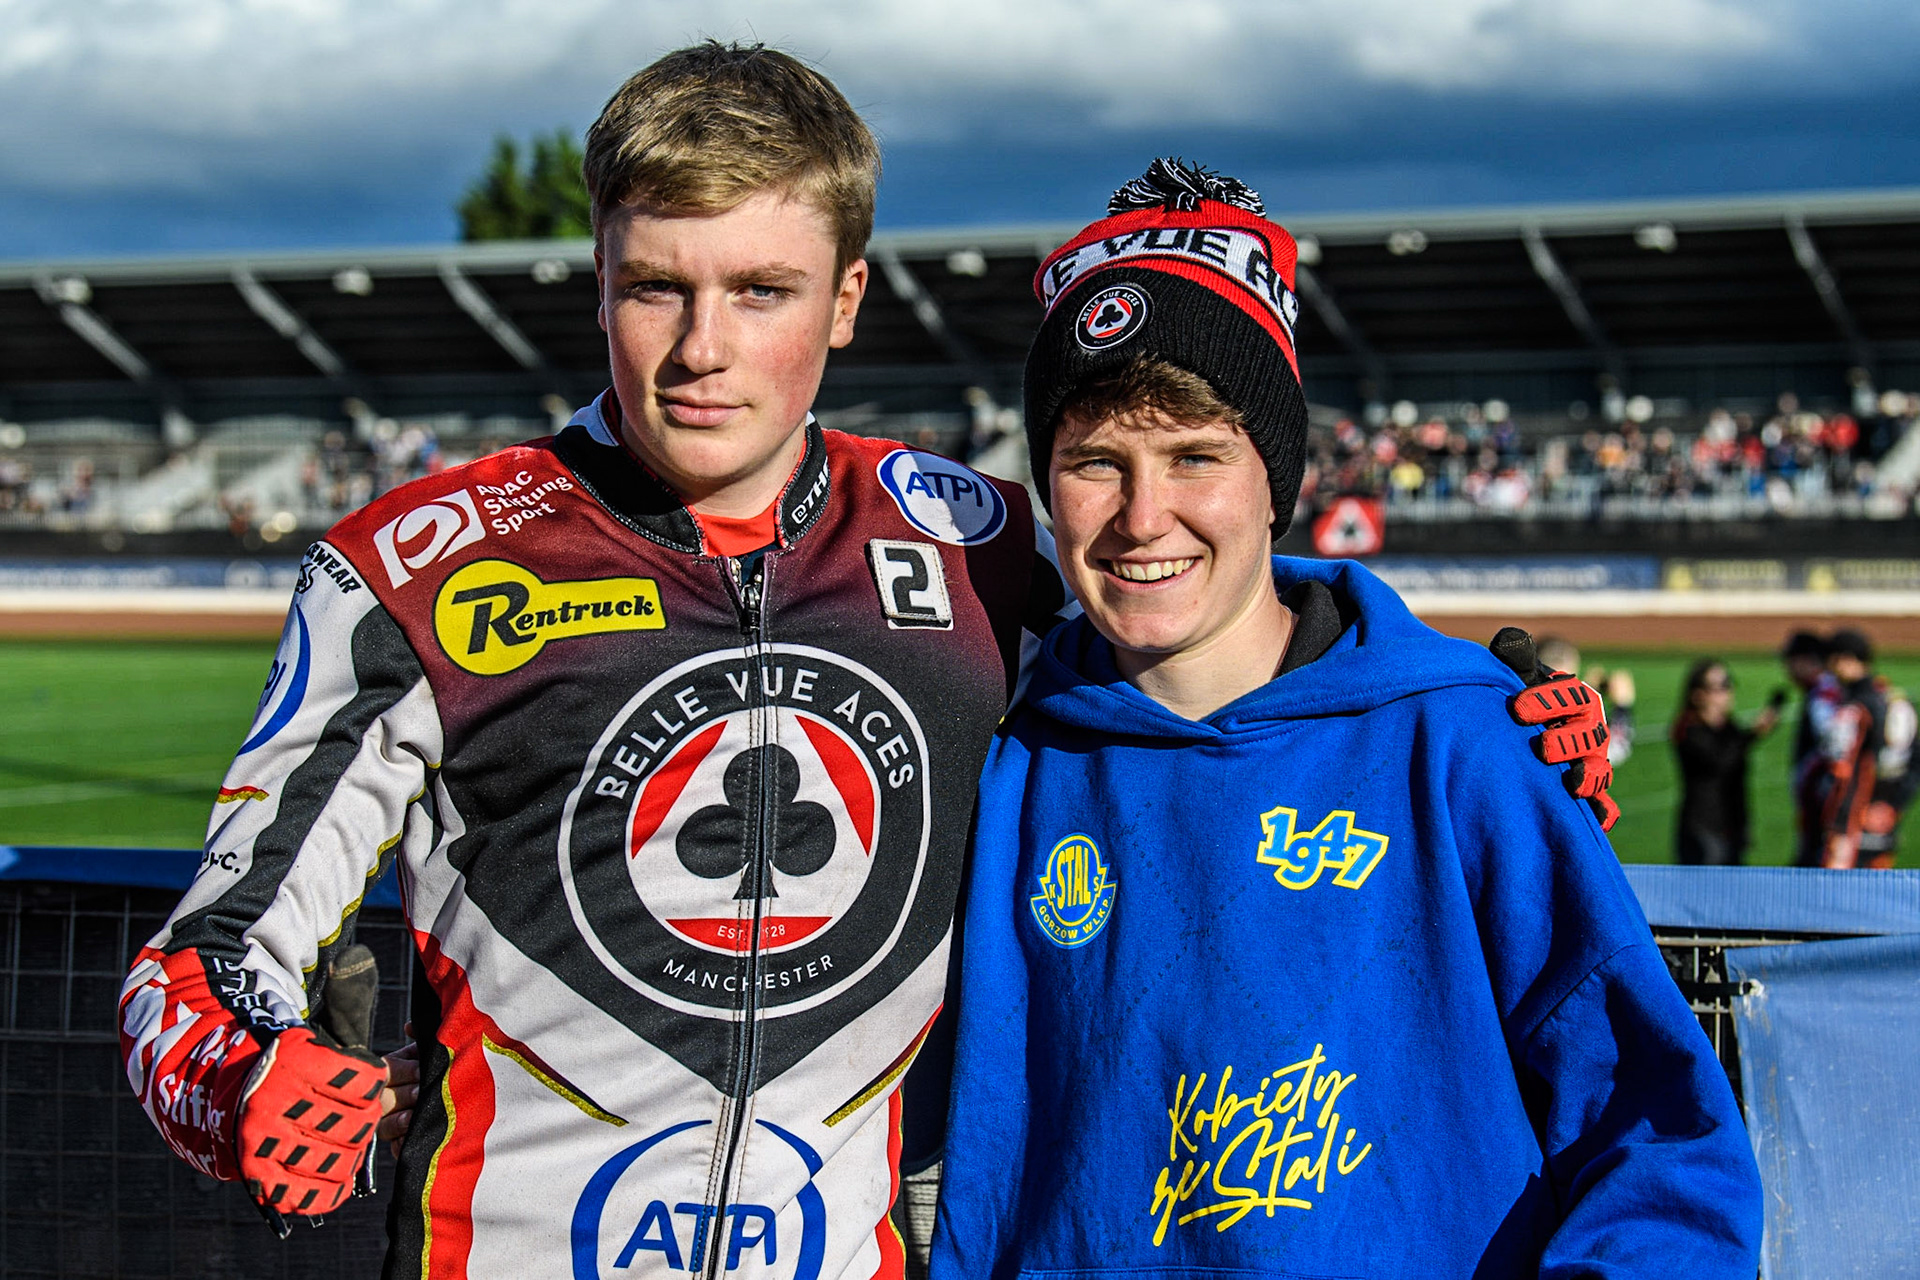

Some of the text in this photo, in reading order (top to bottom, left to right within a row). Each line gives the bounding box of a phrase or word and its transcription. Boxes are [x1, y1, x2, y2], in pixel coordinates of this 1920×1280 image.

[1102, 228, 1231, 267] VUE
[1080, 290, 1140, 322] BELLE VUE ACES
[476, 470, 533, 496] ADAC
[483, 476, 574, 516] Stiftung
[905, 471, 984, 508] ATPI
[491, 501, 557, 536] Sport
[884, 546, 937, 616] 2
[451, 581, 656, 656] Rentruck
[595, 666, 915, 800] BELLE VUE ACES
[1056, 844, 1091, 910] STAL
[1256, 806, 1390, 890] 1947
[662, 953, 834, 992] MANCHESTER
[1168, 1043, 1357, 1161] Kobiety
[1212, 1112, 1373, 1233] Stali
[613, 1199, 778, 1273] ATPI
